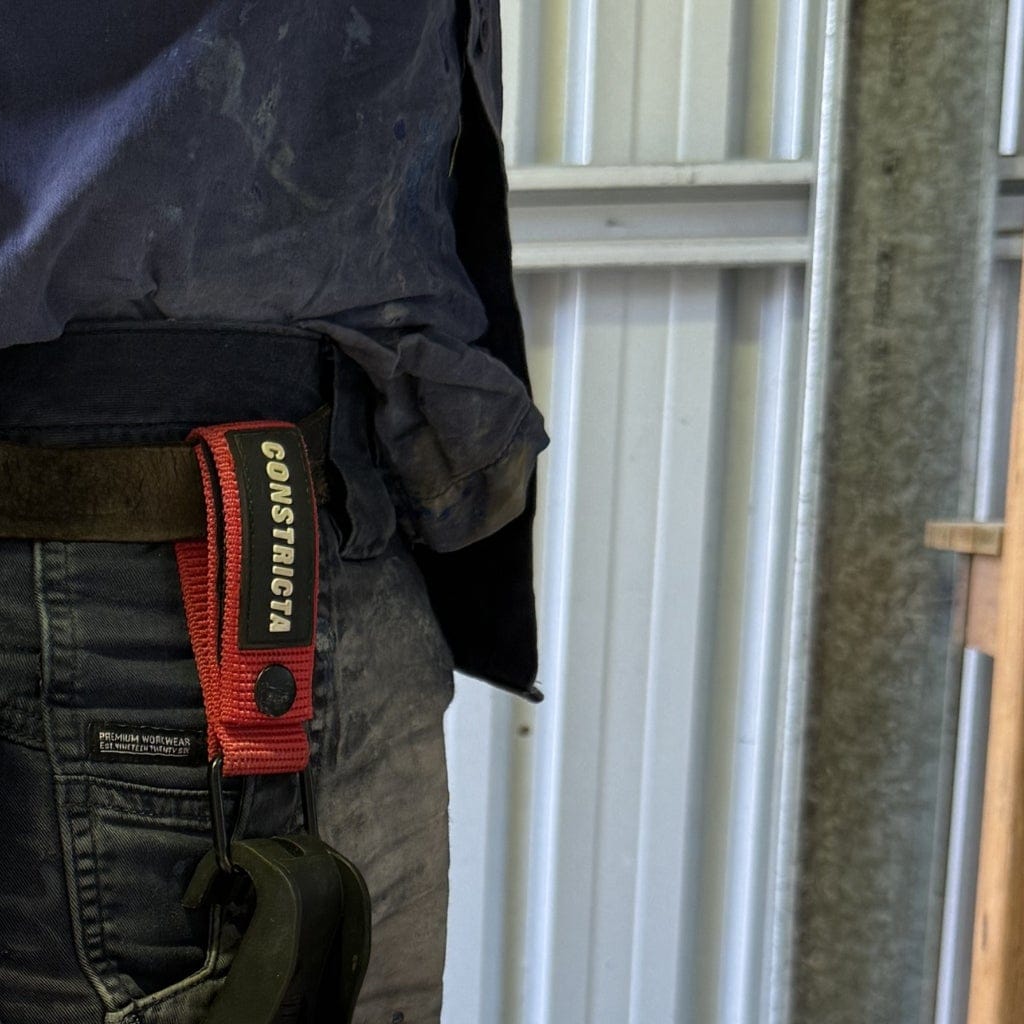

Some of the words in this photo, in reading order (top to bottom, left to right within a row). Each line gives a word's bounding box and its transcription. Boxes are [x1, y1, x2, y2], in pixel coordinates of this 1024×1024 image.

[262, 441, 295, 633] CONSTRICTA
[99, 732, 139, 744] PREMIUM
[141, 735, 191, 746] WORKWEAR
